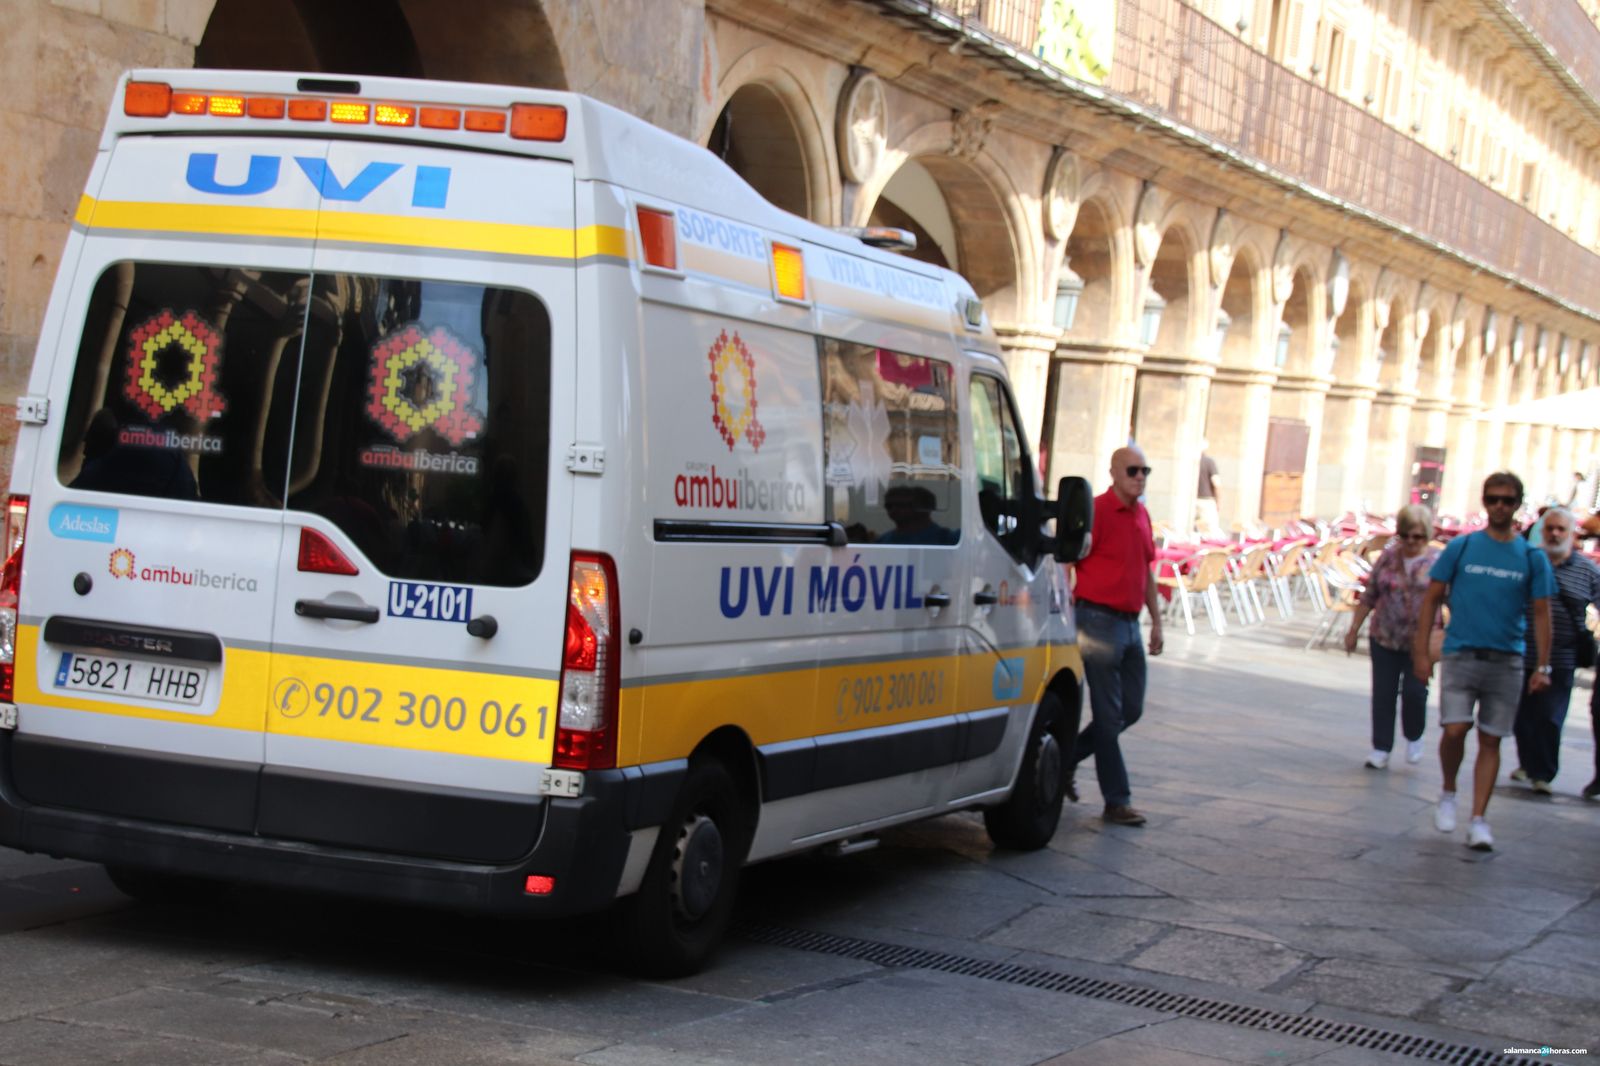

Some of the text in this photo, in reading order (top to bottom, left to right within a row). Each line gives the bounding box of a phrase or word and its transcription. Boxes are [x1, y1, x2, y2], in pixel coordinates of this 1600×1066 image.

[186, 153, 452, 209] UVI
[677, 208, 766, 259] SOPORTE
[826, 254, 871, 289] VITAL
[118, 429, 222, 452] ambuiberica
[361, 448, 478, 475] ambuiberica
[674, 464, 806, 512] ambuiberica
[59, 514, 111, 535] Adeslas
[140, 566, 258, 592] ambuiberica
[719, 553, 924, 619] UVI MÓVIL
[390, 582, 469, 621] U-2101
[83, 630, 174, 653] MASTER
[71, 657, 133, 691] 5821
[147, 667, 200, 699] HHB
[852, 669, 945, 715] 902 300 061
[314, 682, 549, 740] 902 300 061
